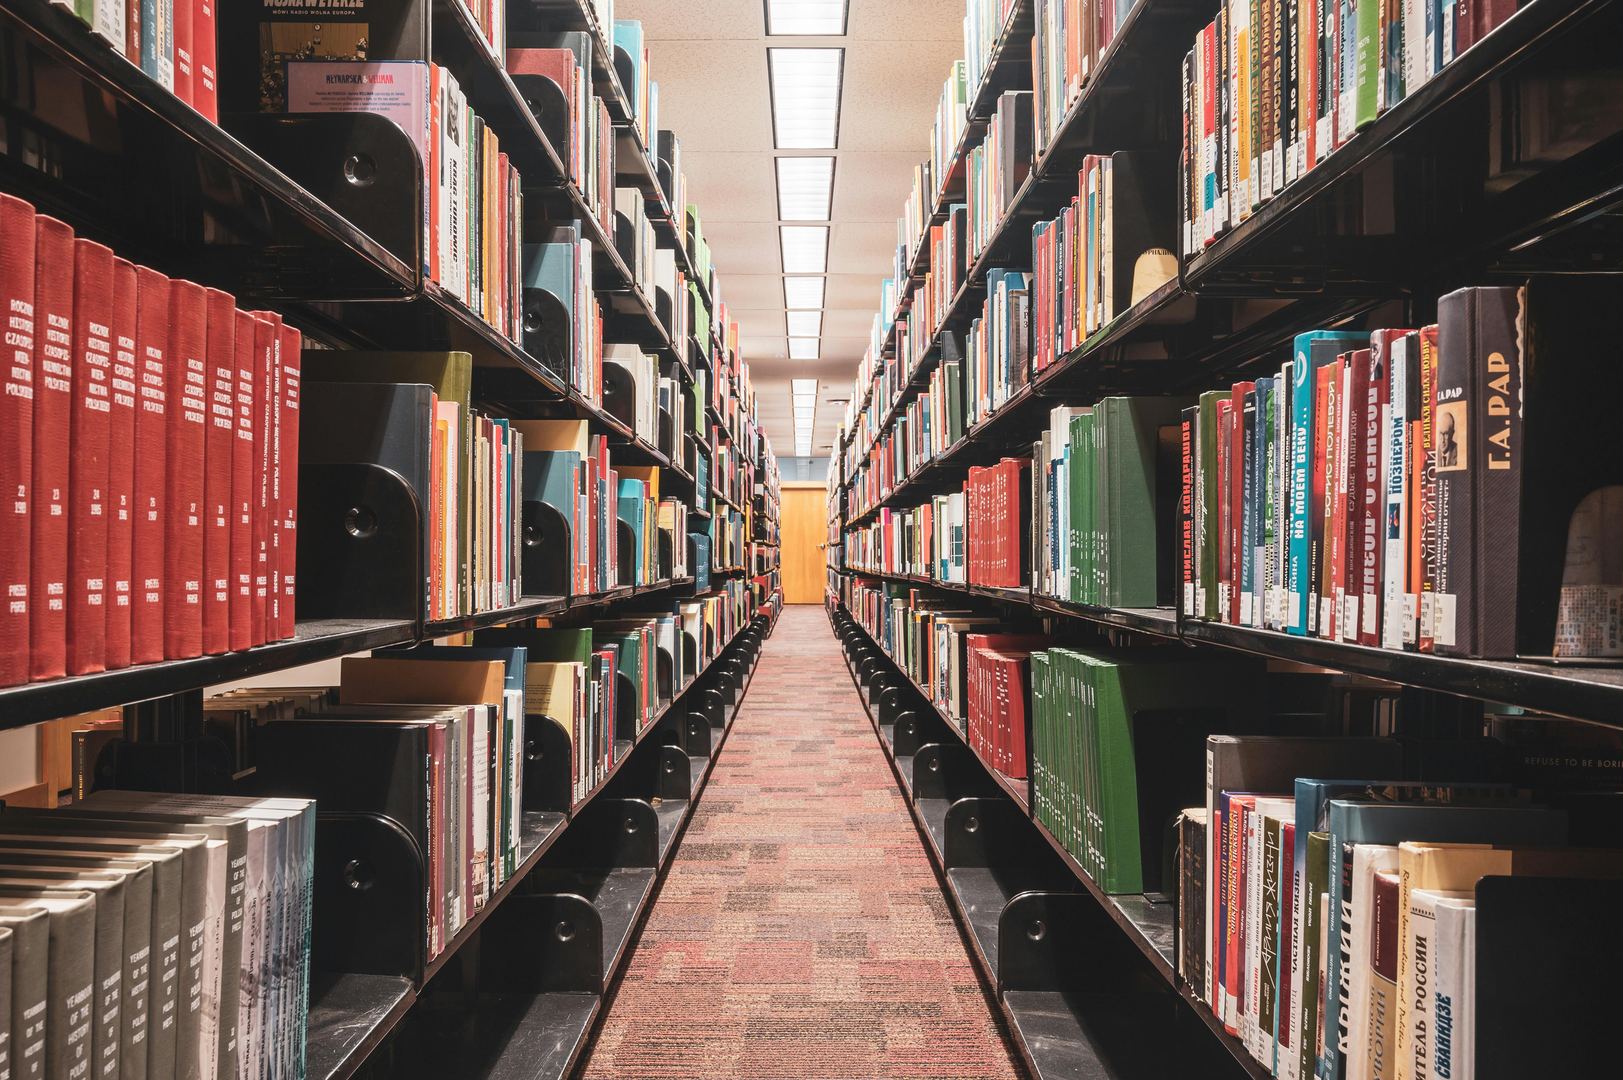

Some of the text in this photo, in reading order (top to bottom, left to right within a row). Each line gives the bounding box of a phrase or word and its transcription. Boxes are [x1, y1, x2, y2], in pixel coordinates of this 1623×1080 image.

[1327, 381, 1335, 459] ПОЛЕВОЙ
[1423, 405, 1431, 448] ВЕЛИКАЯ
[1487, 352, 1511, 470] Г.А.РАР
[1182, 421, 1191, 514] КОНДРАШОВ
[1295, 468, 1305, 514] МОЕМ
[1392, 416, 1403, 494] ПОЗНЕРОМ
[1242, 502, 1250, 587] ПОДОБНЫЕ
[1265, 519, 1272, 530] Я
[1294, 518, 1304, 539] НА
[1425, 450, 1436, 577] ПУШКИНОЙ
[1524, 757, 1560, 766] REFUSE
[1564, 758, 1578, 767] TO
[1230, 867, 1238, 934] открытым
[1261, 832, 1279, 988] АРМИЯ ЖИЗНИ
[1402, 870, 1410, 910] Russian
[1401, 915, 1409, 976] Journalism
[1415, 935, 1427, 1013] РОССИИ
[1398, 1007, 1406, 1049] Politics
[1437, 992, 1453, 1079] СВАНИДЗЕ
